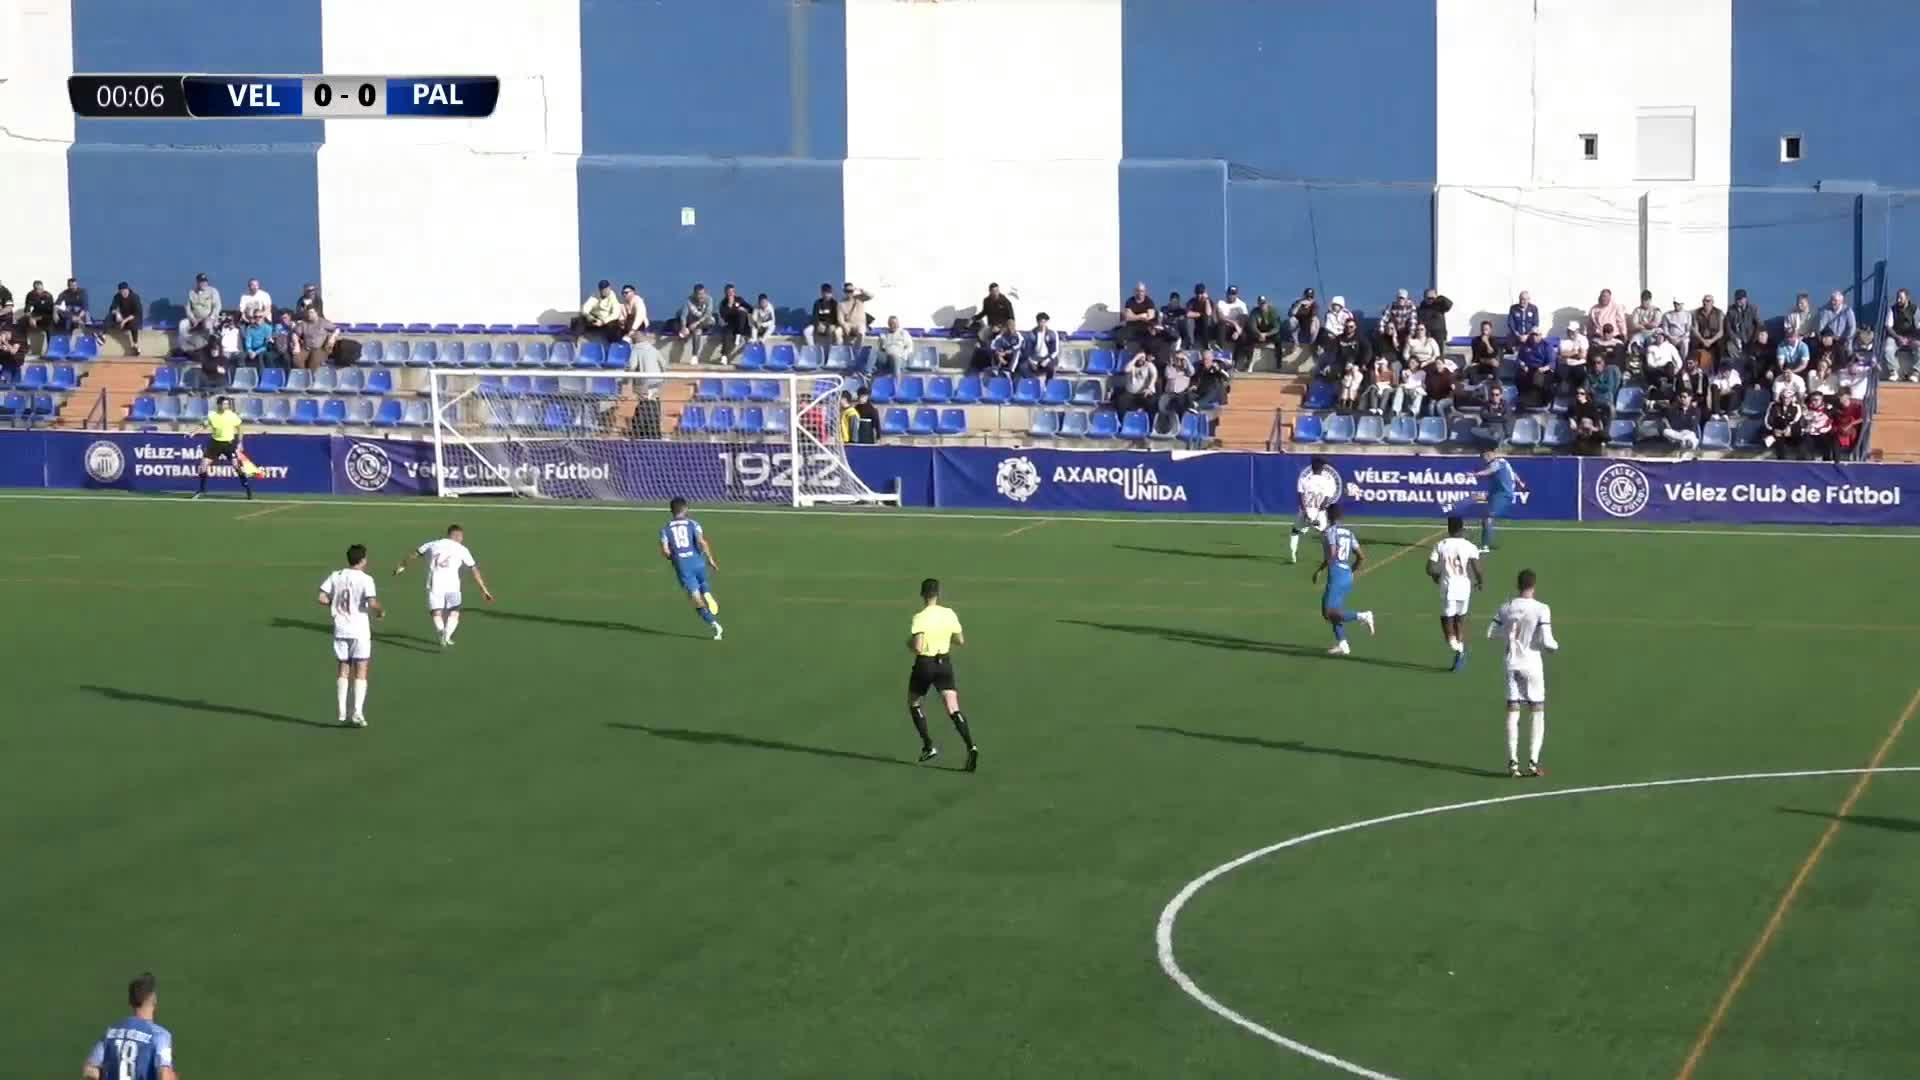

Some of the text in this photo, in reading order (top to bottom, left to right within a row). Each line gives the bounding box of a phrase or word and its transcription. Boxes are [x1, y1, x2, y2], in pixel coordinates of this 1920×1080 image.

[545, 461, 610, 480] Fútbol
[718, 452, 841, 487] 1922
[1353, 468, 1477, 485] VÉLEZ-MÁLAGA
[1664, 483, 1900, 505] Vélez Club de Fútbol
[115, 1039, 138, 1080] 18
